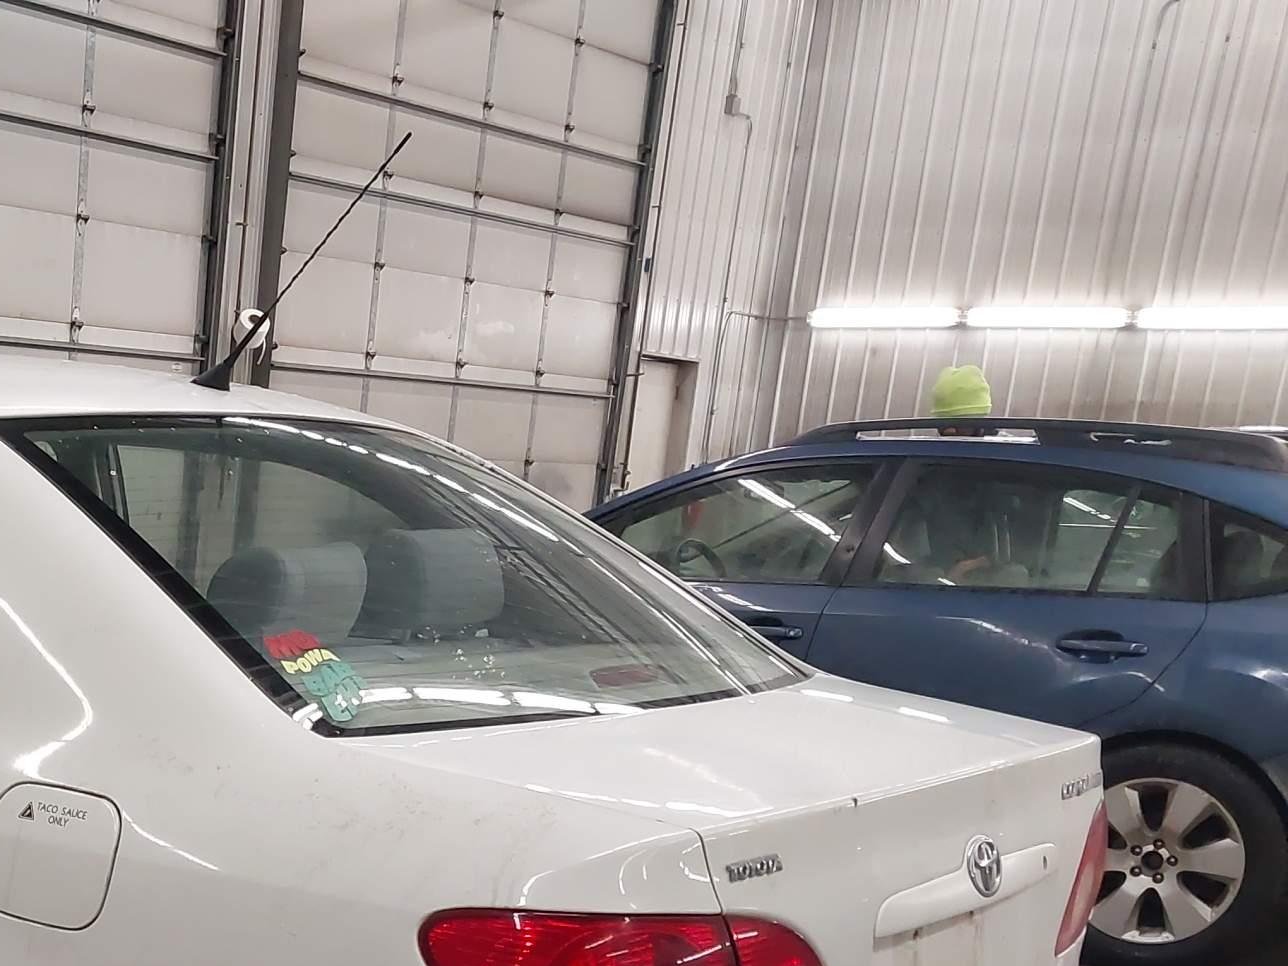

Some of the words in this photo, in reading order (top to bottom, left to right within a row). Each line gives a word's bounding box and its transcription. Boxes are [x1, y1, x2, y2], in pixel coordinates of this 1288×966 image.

[280, 648, 341, 674] POWA
[37, 801, 59, 814] TACO
[61, 806, 88, 820] SAUCE
[48, 815, 70, 828] ONLY
